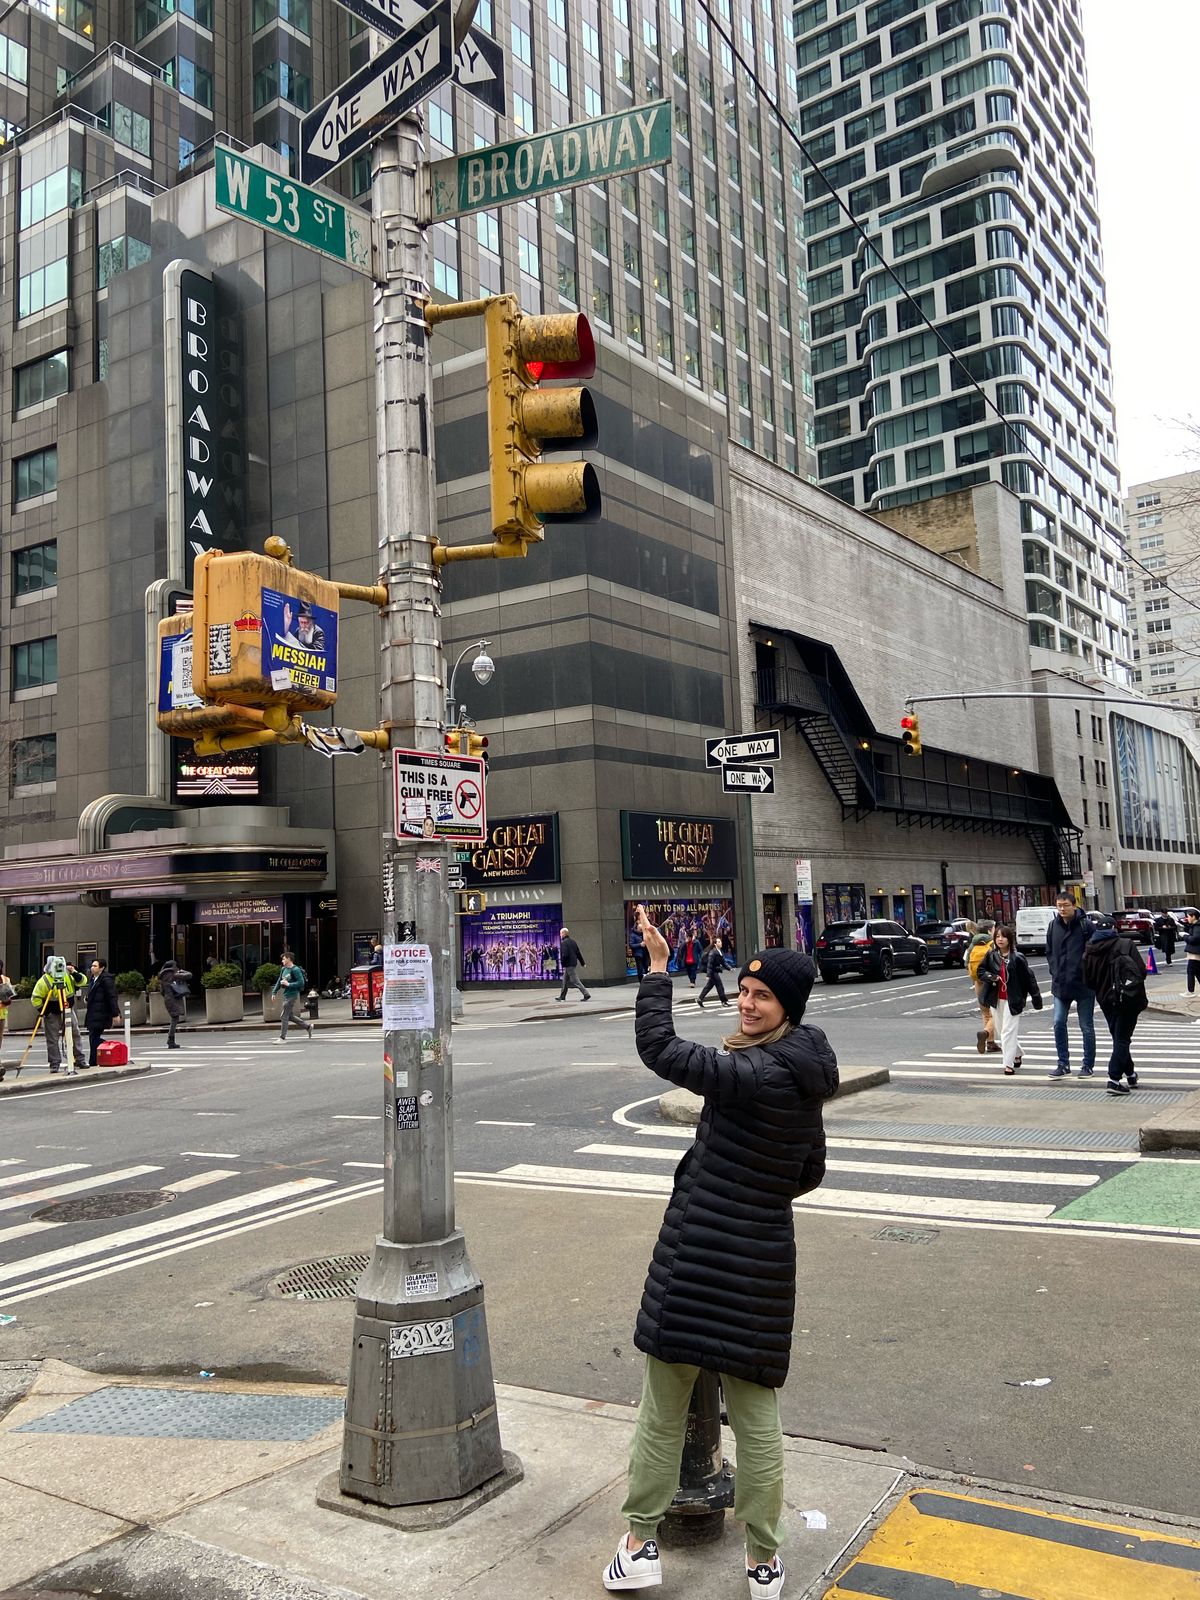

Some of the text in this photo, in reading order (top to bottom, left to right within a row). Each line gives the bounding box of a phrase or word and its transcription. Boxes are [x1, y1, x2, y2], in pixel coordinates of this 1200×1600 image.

[321, 96, 361, 151] ONE
[382, 39, 431, 102] WAY
[466, 108, 658, 204] BROADWAY
[224, 155, 336, 234] W 53 ST
[272, 644, 326, 672] MESSIAH
[293, 671, 319, 687] HERE!
[718, 741, 769, 758] ONE WAY
[181, 765, 196, 775] THE
[197, 766, 223, 775] GREAT
[400, 771, 448, 786] THIS IS A
[731, 772, 766, 785] ONE WAY
[401, 787, 453, 801] GUN FREE
[493, 824, 545, 847] GREAT
[656, 818, 714, 844] THE GREAT
[472, 846, 537, 870] GATSBY
[664, 844, 709, 865] GATSBY
[497, 912, 531, 920] TRIUMPH!
[398, 1097, 415, 1106] AWER
[398, 1113, 418, 1121] DON'T
[406, 1273, 436, 1281] SOLARPUNK
